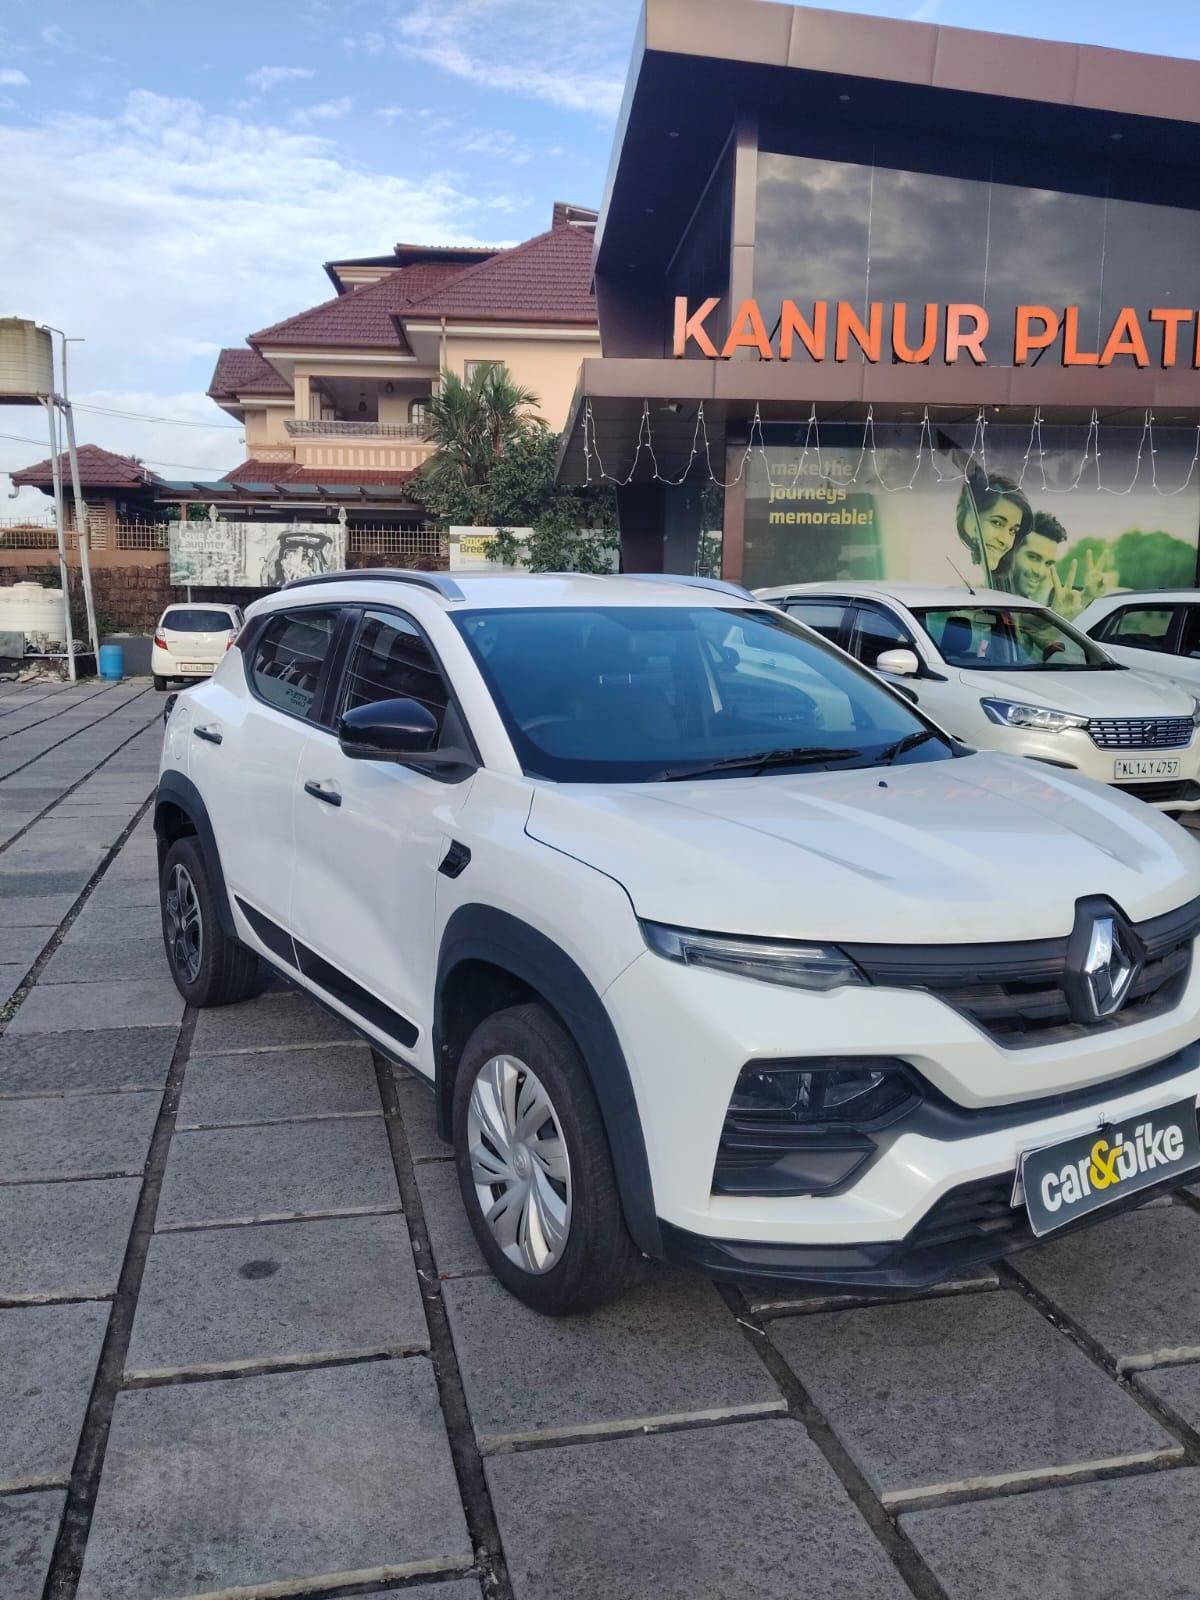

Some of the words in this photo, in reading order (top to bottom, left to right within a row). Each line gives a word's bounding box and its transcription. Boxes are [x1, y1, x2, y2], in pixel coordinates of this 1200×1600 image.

[673, 296, 989, 364] KANNUR
[771, 460, 819, 476] make
[823, 459, 853, 476] the
[769, 485, 847, 505] journeys
[769, 508, 873, 525] memorable!
[179, 525, 205, 540] Love
[179, 539, 226, 551] Laughter
[1041, 1122, 1185, 1212] car&bike
